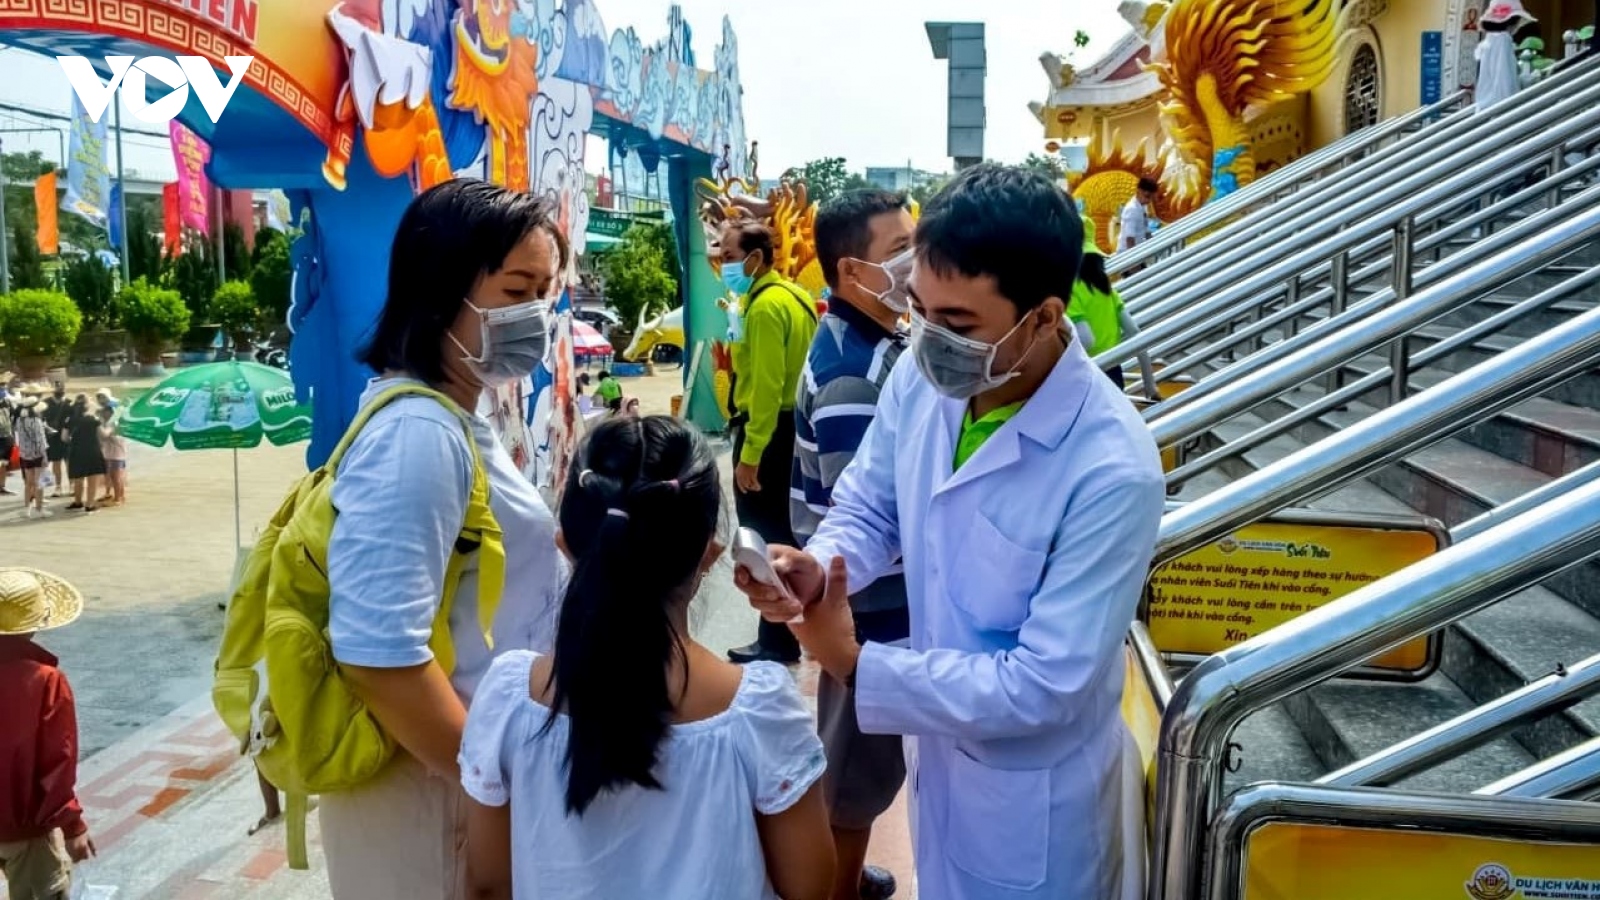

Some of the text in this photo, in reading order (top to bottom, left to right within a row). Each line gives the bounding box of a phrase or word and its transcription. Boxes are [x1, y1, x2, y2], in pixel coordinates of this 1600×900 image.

[1171, 562, 1203, 573] khách
[1205, 564, 1222, 573] vui
[1225, 564, 1248, 577] lòng
[1250, 565, 1270, 577] xếp
[1272, 567, 1300, 579] hàng
[1302, 568, 1327, 579] theo
[1329, 571, 1344, 582] sự
[1160, 576, 1188, 585] nhân
[1190, 577, 1212, 587] viên
[1214, 578, 1237, 588] Suối
[1240, 579, 1261, 590] Tiên
[1262, 580, 1279, 591] khi
[1282, 583, 1301, 593] vào
[1302, 583, 1332, 596] cổng.
[1171, 594, 1203, 605] khách
[1207, 597, 1223, 607] vui
[1226, 597, 1251, 610] lòng
[1280, 601, 1302, 611] trên
[1186, 609, 1203, 619] khi
[1206, 612, 1225, 621] vào
[1226, 612, 1255, 625] cổng.
[1225, 628, 1248, 641] Xin
[1516, 879, 1533, 888] DU
[1536, 878, 1561, 891] LỊCH
[1565, 880, 1589, 891] VĂN
